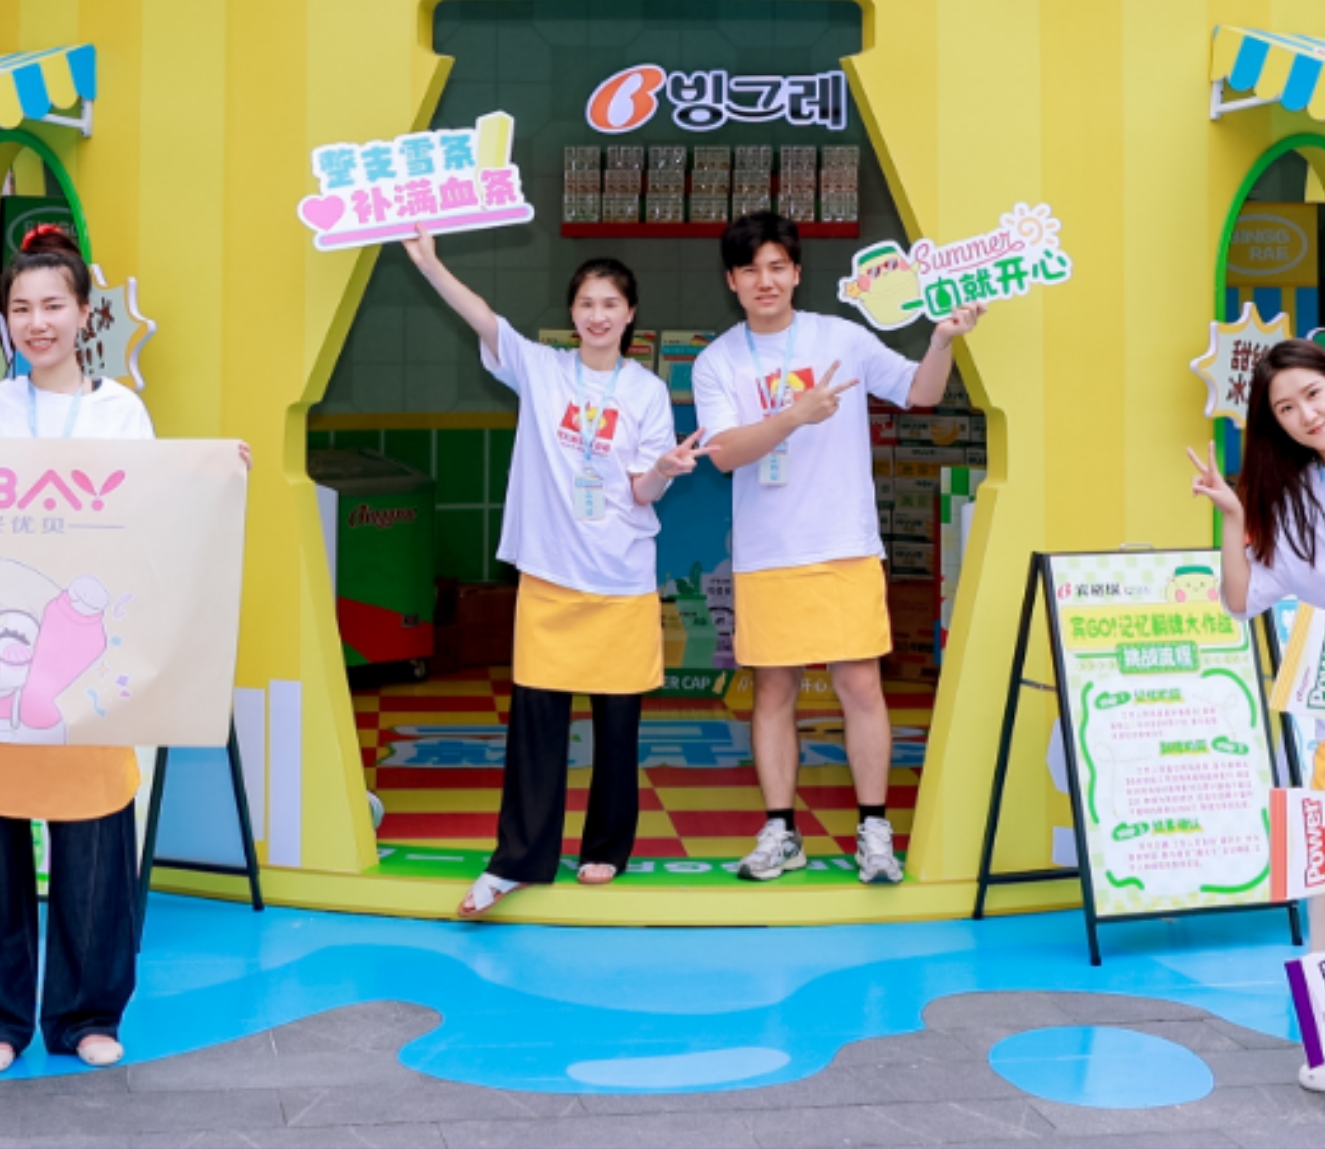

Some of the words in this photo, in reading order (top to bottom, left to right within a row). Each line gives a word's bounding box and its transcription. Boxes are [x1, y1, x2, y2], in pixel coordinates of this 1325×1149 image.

[669, 72, 843, 128] 빙그레
[319, 133, 477, 190] 整支雪条
[350, 169, 518, 225] 补满血条
[914, 229, 1026, 275] Summer
